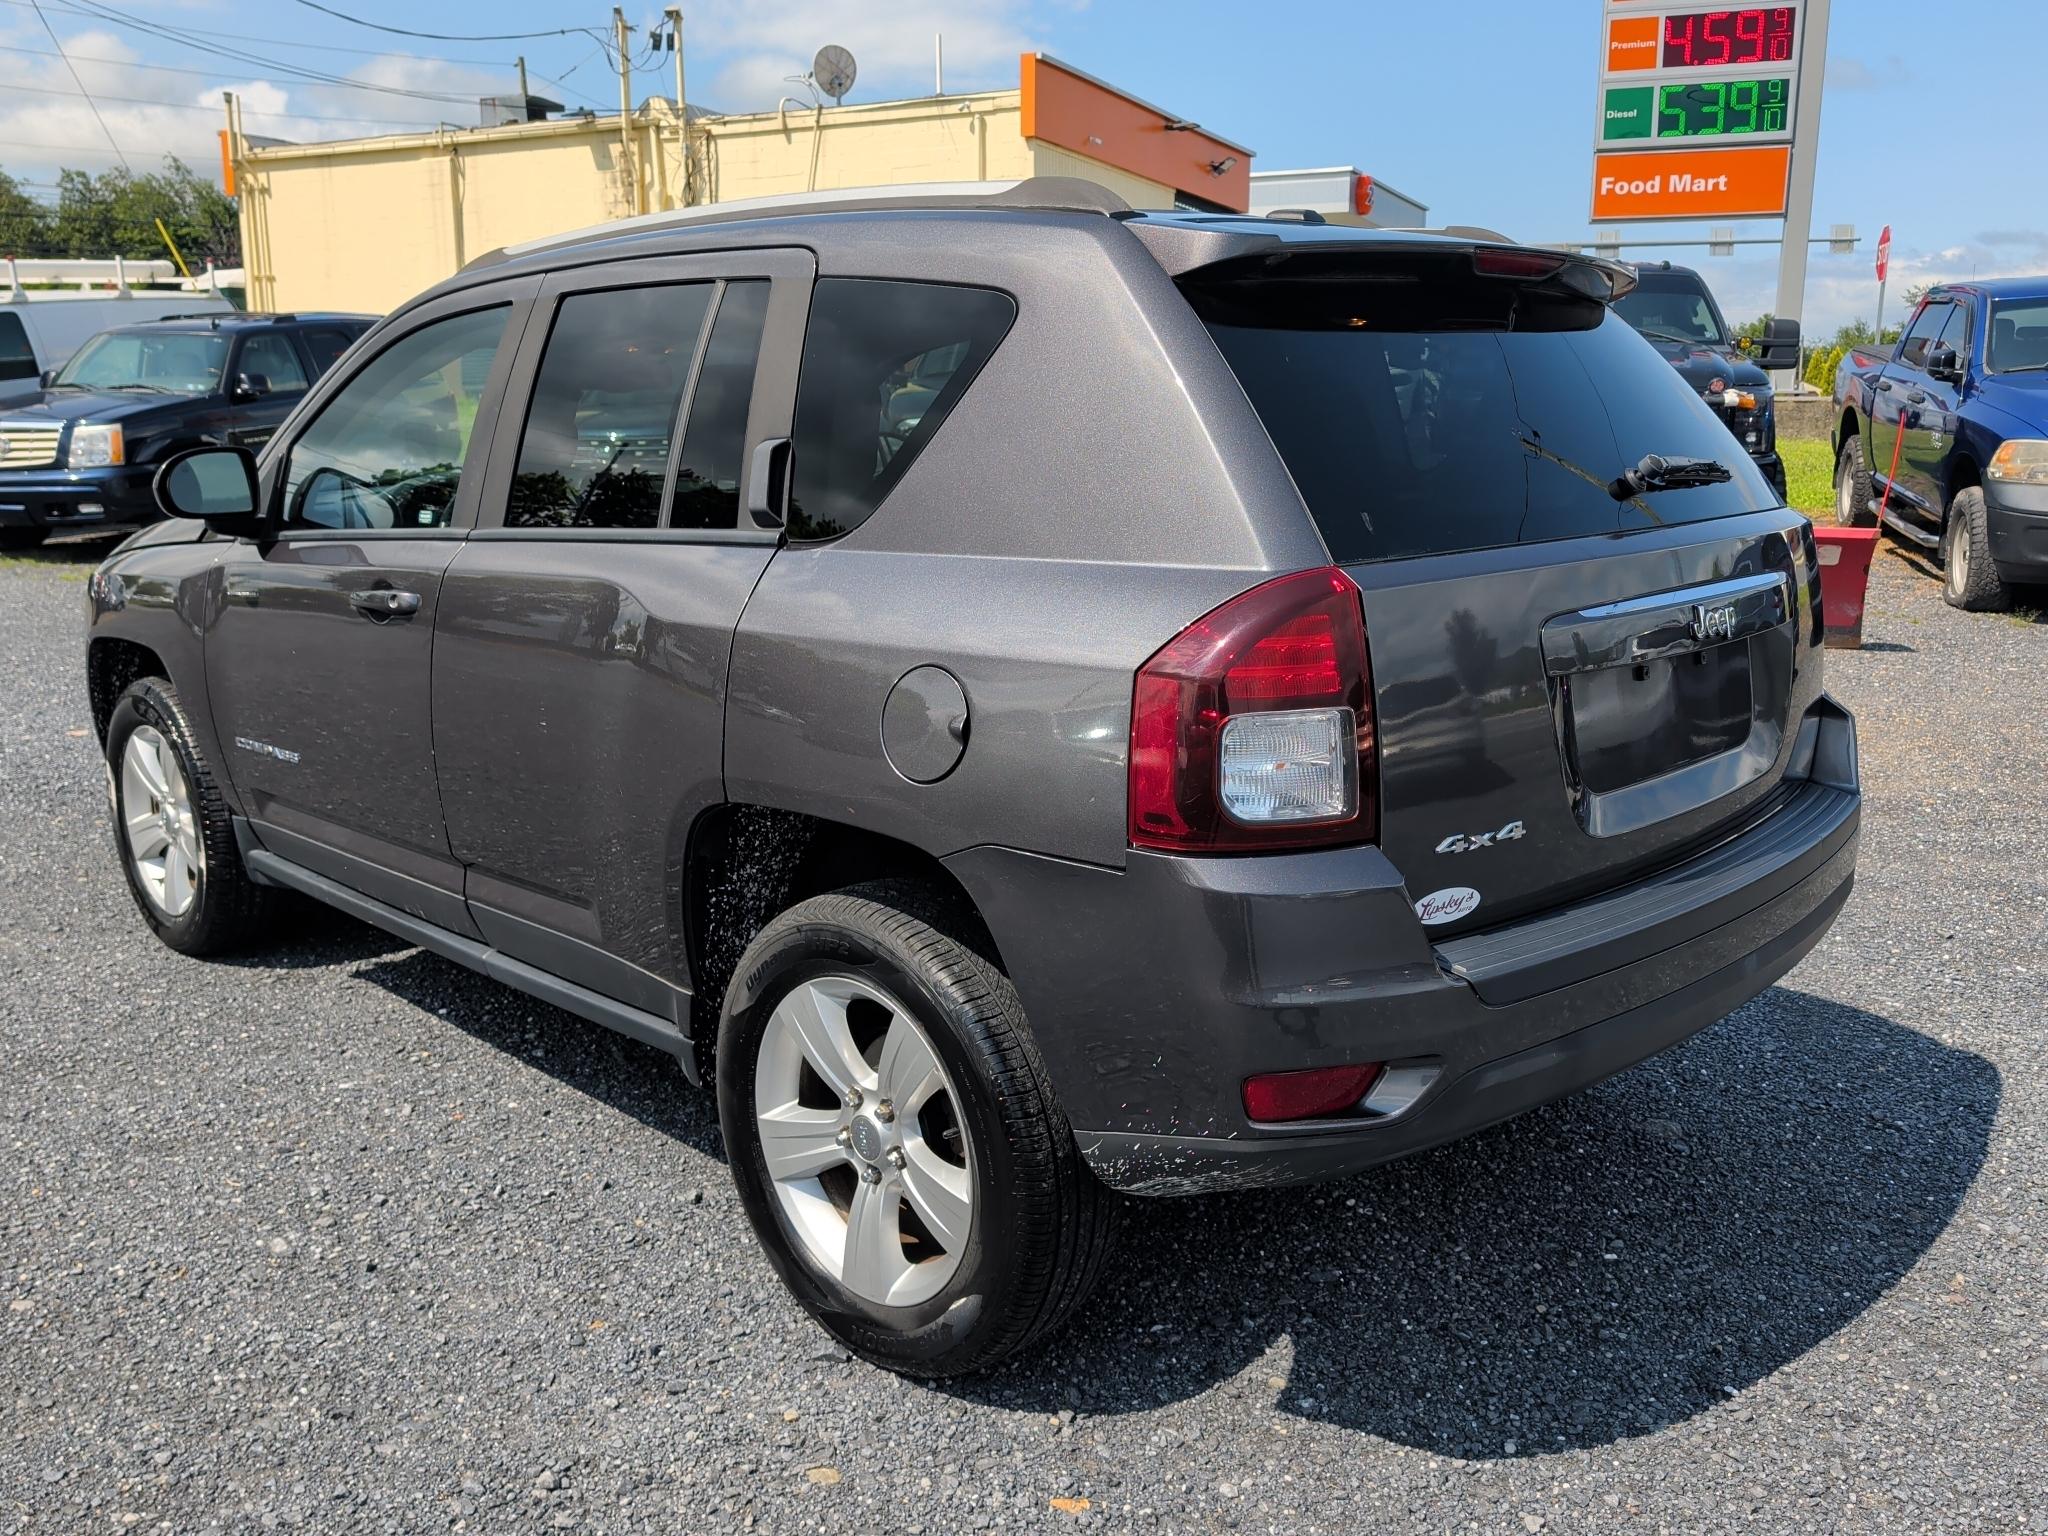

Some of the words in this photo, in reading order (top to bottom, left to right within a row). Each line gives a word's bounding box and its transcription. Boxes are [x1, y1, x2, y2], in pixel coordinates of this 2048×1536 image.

[1611, 39, 1656, 50] Premium
[1665, 10, 1765, 66] 4.59
[1606, 109, 1637, 119] Diesel
[1659, 81, 1759, 137] 5.39
[1600, 176, 1661, 196] Food
[1668, 174, 1728, 194] Mart
[1691, 604, 1736, 640] Jeep
[1434, 820, 1527, 854] 4x4
